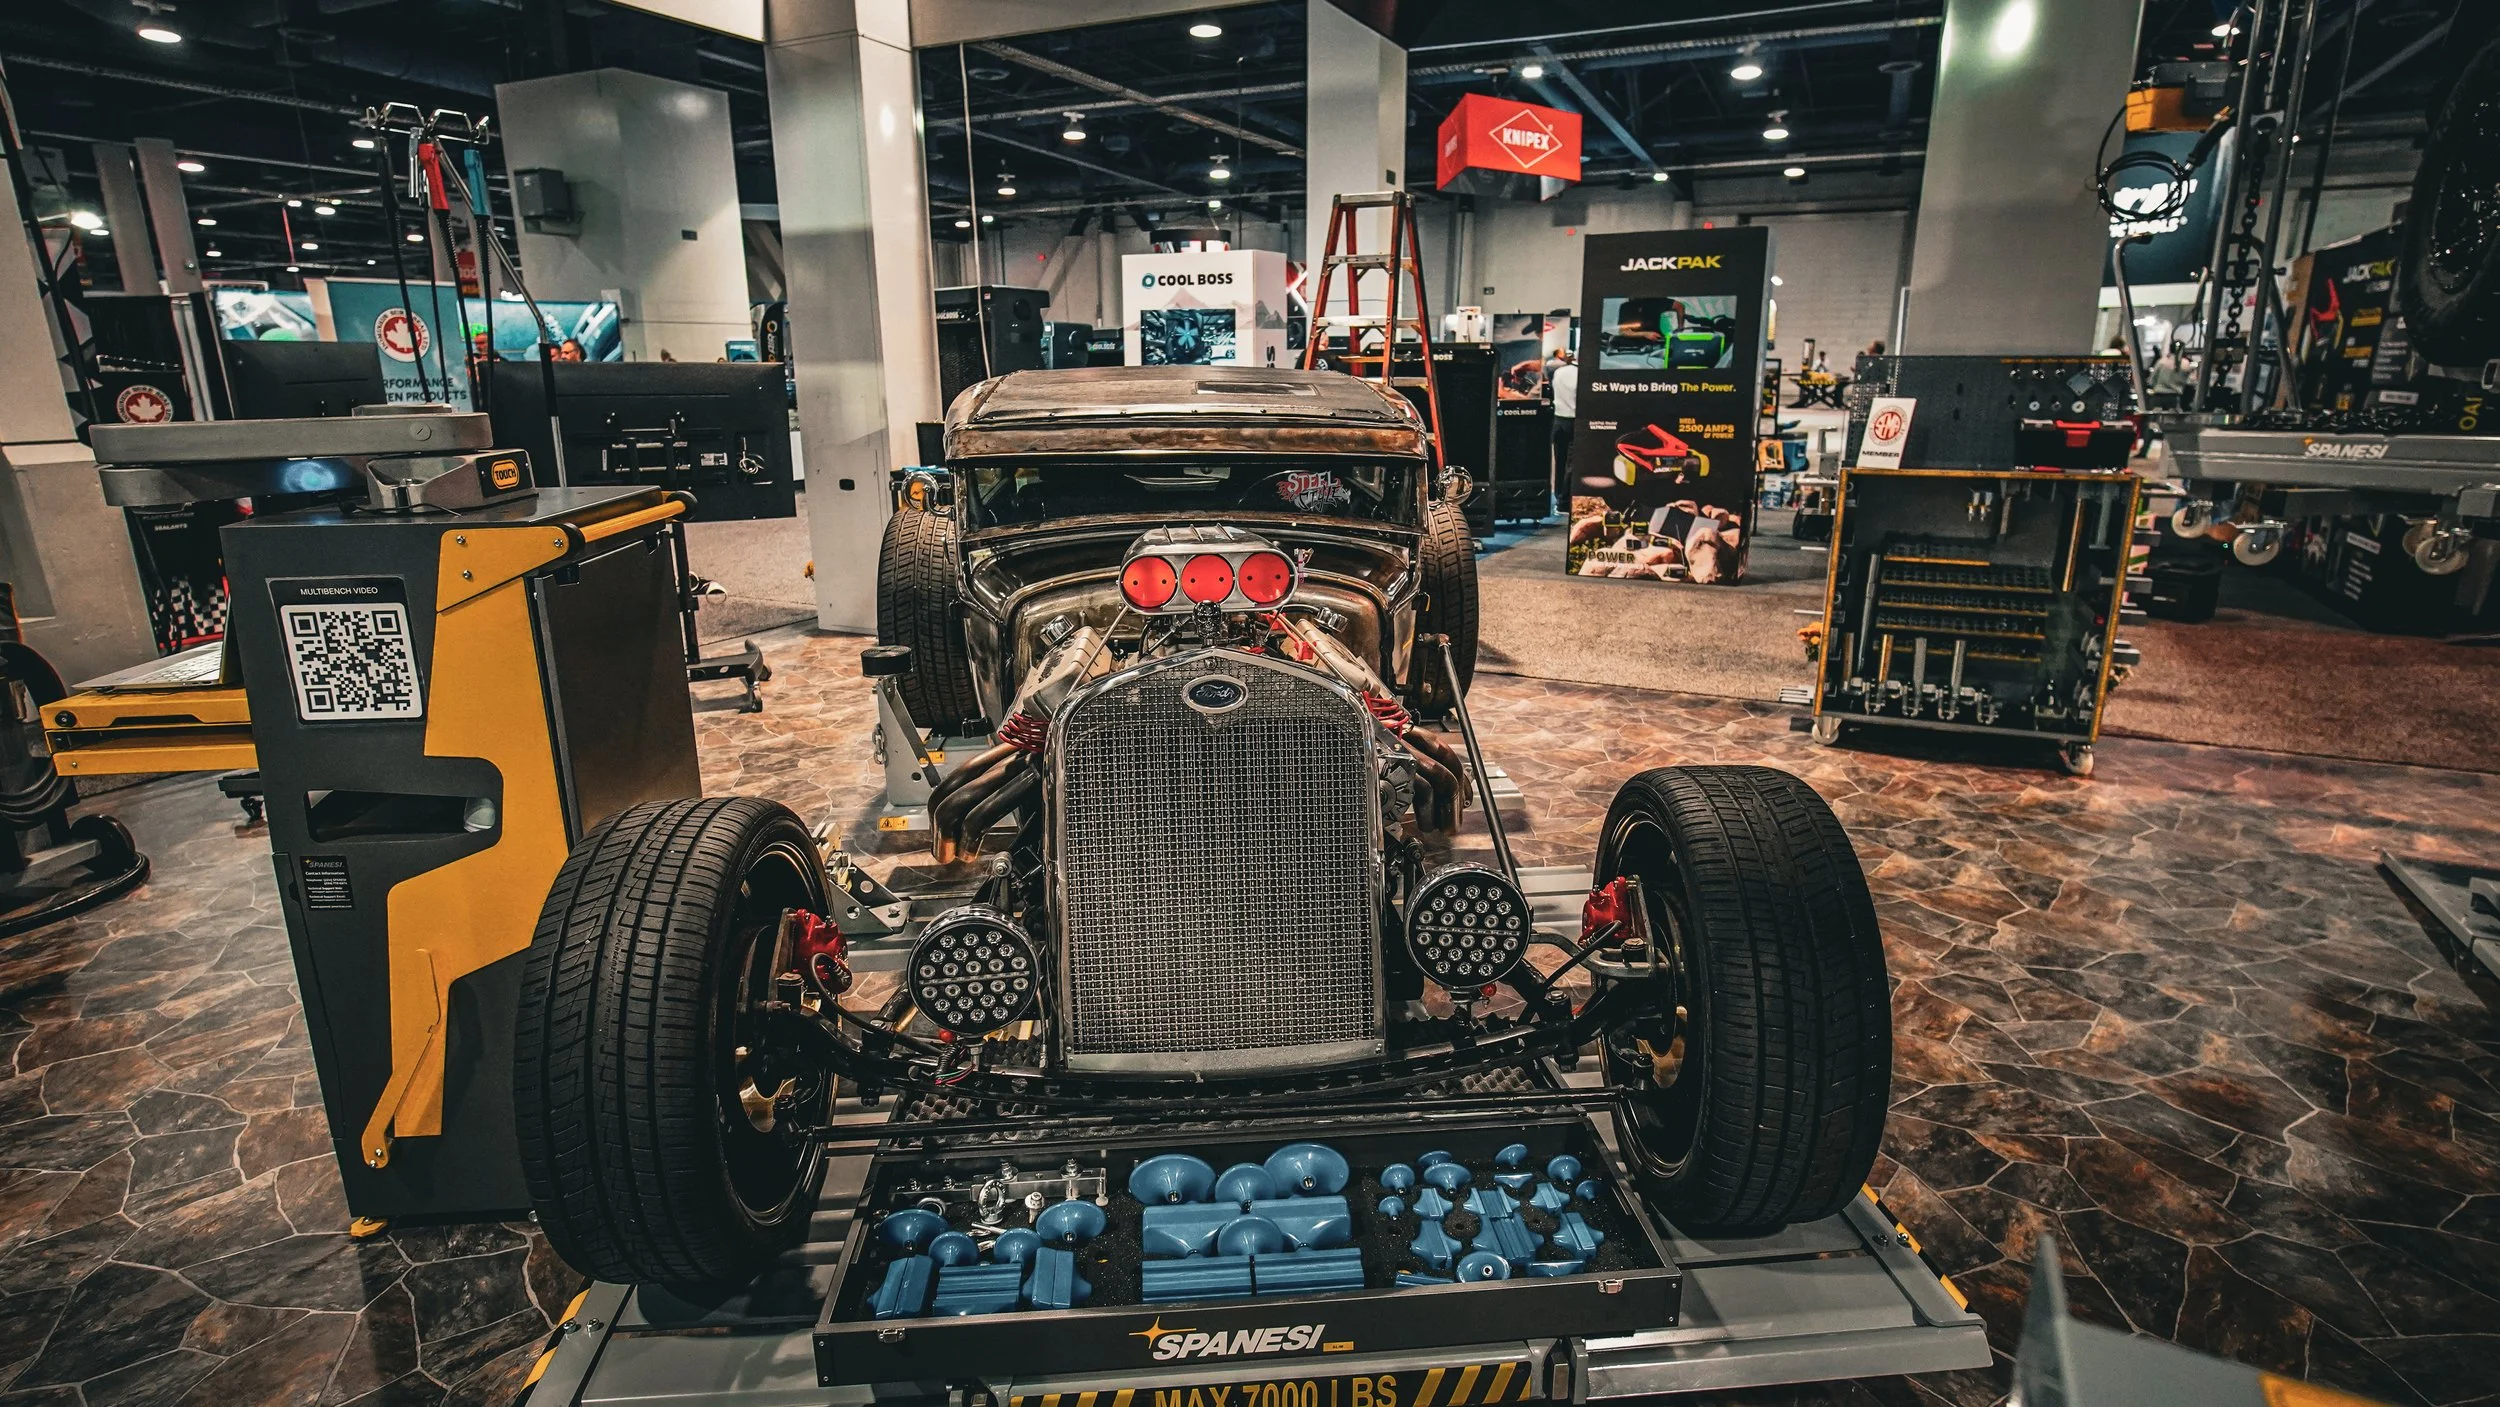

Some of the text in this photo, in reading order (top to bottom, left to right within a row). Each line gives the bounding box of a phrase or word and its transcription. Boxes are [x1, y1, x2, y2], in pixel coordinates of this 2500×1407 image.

[1502, 127, 1550, 150] KNIPEX
[1620, 255, 1723, 271] JACKPAK
[1158, 273, 1233, 286] COOL BOSS
[383, 377, 454, 389] RFORMANE
[1592, 382, 1737, 394] Six Ways to Bring The Power.
[1678, 424, 1735, 433] 2500 AMPS
[1861, 450, 1900, 458] MEMBER
[2304, 443, 2389, 458] SPANESI
[495, 468, 517, 480] TOUCH
[1287, 470, 1338, 493] STEEL
[1588, 550, 1636, 563] POWER
[300, 586, 378, 596] MULTIBENCH VIDEO
[1195, 684, 1235, 698] Ford
[609, 929, 623, 982] REPLACEMENT
[1152, 1323, 1326, 1361] SPANESI
[1155, 1375, 1398, 1407] MAX 7000 LBS
